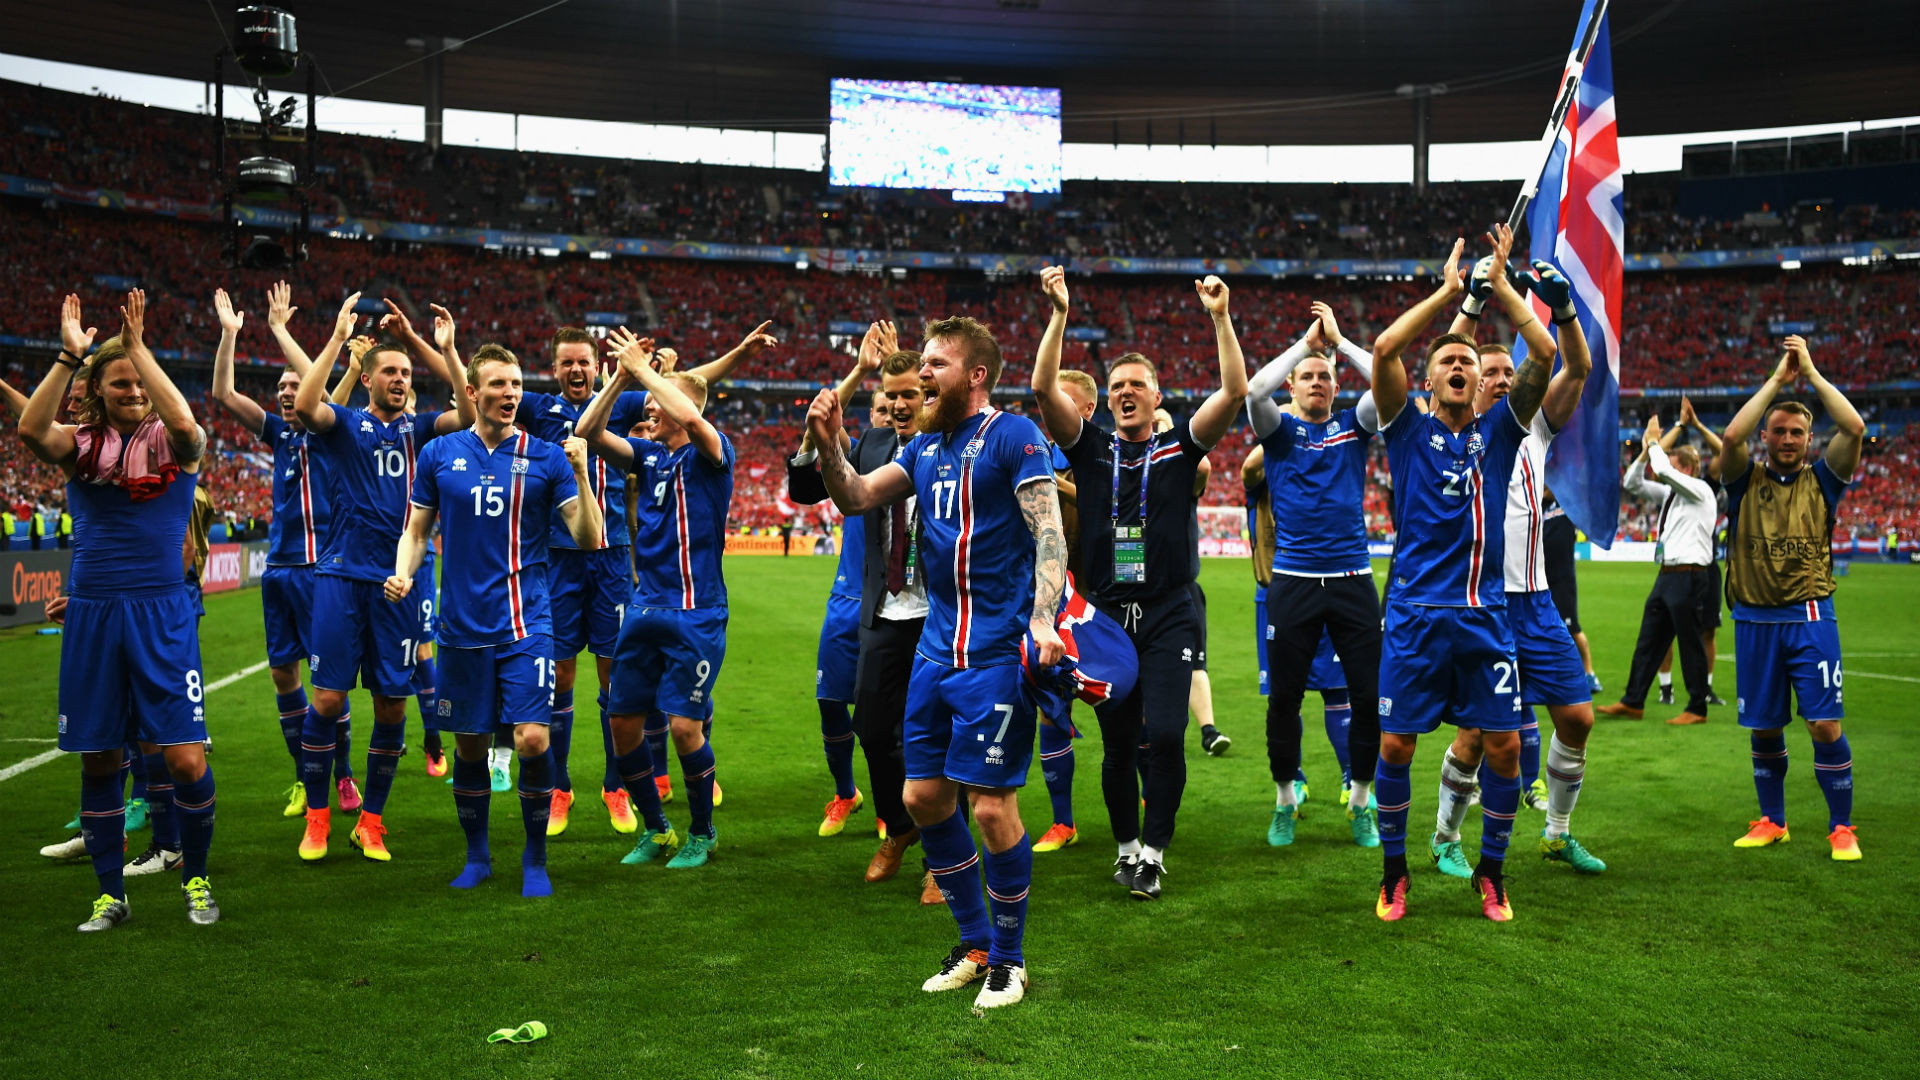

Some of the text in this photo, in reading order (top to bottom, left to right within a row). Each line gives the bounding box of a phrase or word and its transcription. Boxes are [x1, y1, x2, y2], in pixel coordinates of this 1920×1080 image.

[374, 449, 405, 478] 10
[654, 481, 667, 507] 9
[1442, 466, 1472, 497] 21
[470, 485, 505, 517] 15
[932, 480, 957, 520] 17
[211, 552, 240, 583] MOTORS
[13, 561, 62, 606] Orange
[185, 669, 203, 703] 8
[534, 656, 557, 691] 15
[696, 660, 712, 688] 9
[1493, 659, 1521, 694] 21
[1818, 660, 1843, 689] 16
